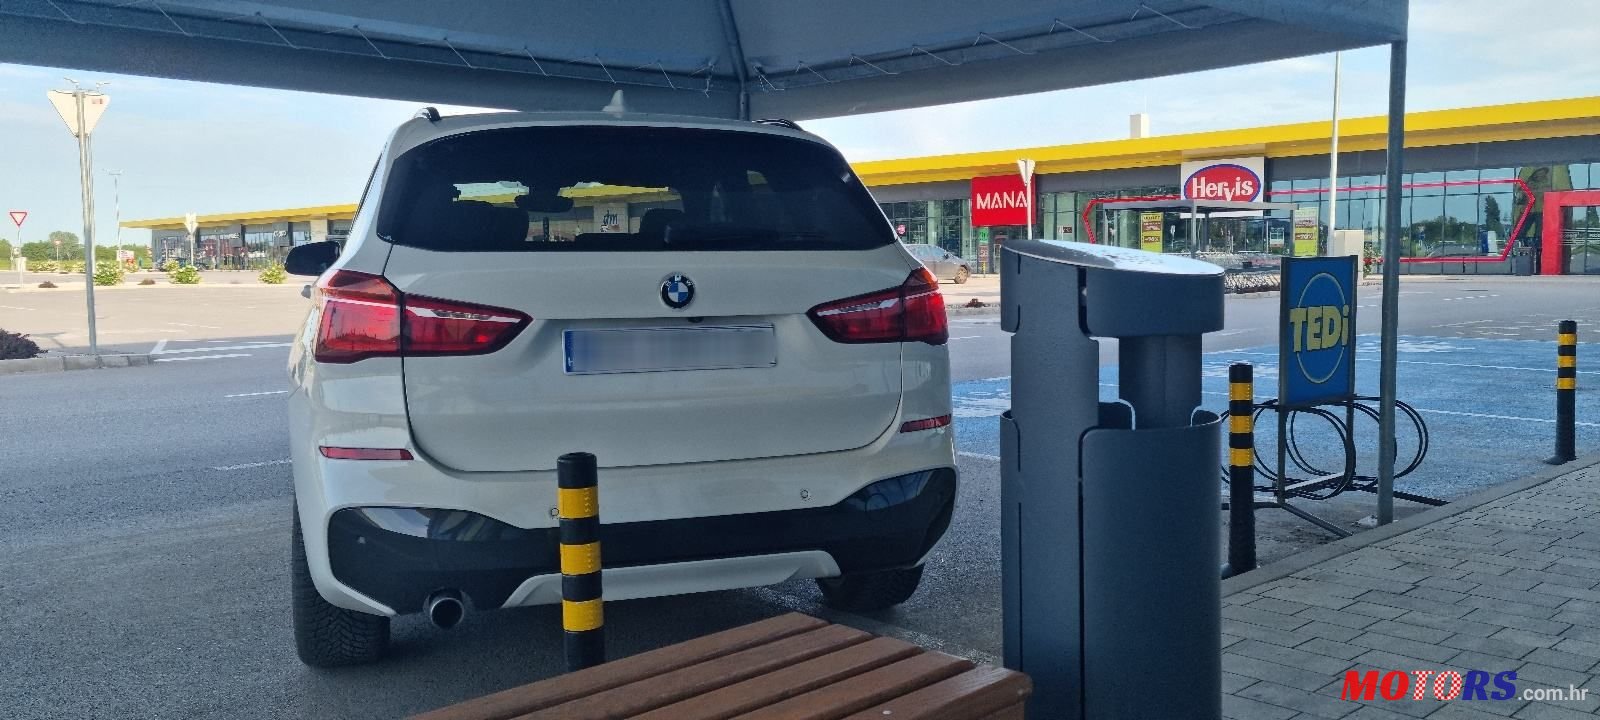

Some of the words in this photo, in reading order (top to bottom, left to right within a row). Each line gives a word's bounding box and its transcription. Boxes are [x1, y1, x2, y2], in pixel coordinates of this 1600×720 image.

[976, 191, 1028, 209] MANA
[1192, 176, 1254, 201] Hervis
[1290, 304, 1350, 353] TEDi
